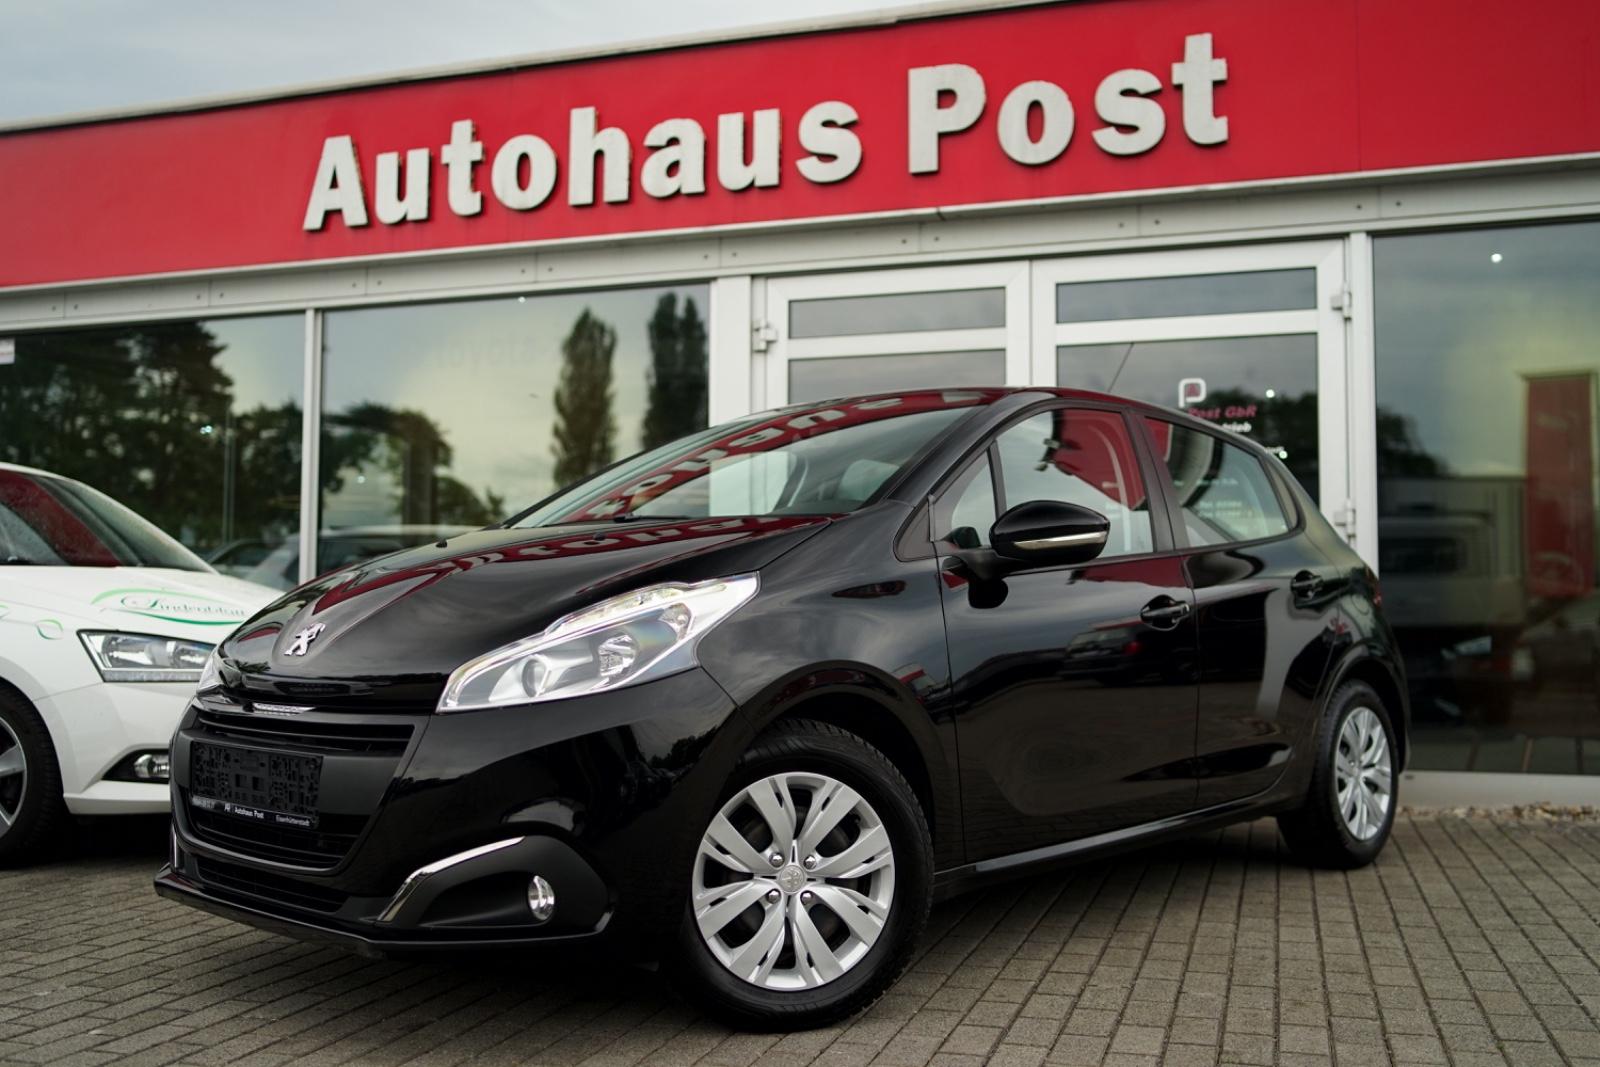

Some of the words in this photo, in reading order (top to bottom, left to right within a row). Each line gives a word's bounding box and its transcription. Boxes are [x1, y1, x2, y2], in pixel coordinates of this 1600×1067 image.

[303, 101, 862, 231] Autohaus
[908, 32, 1229, 174] Post
[235, 806, 253, 817] Autohaus
[254, 810, 264, 819] Post
